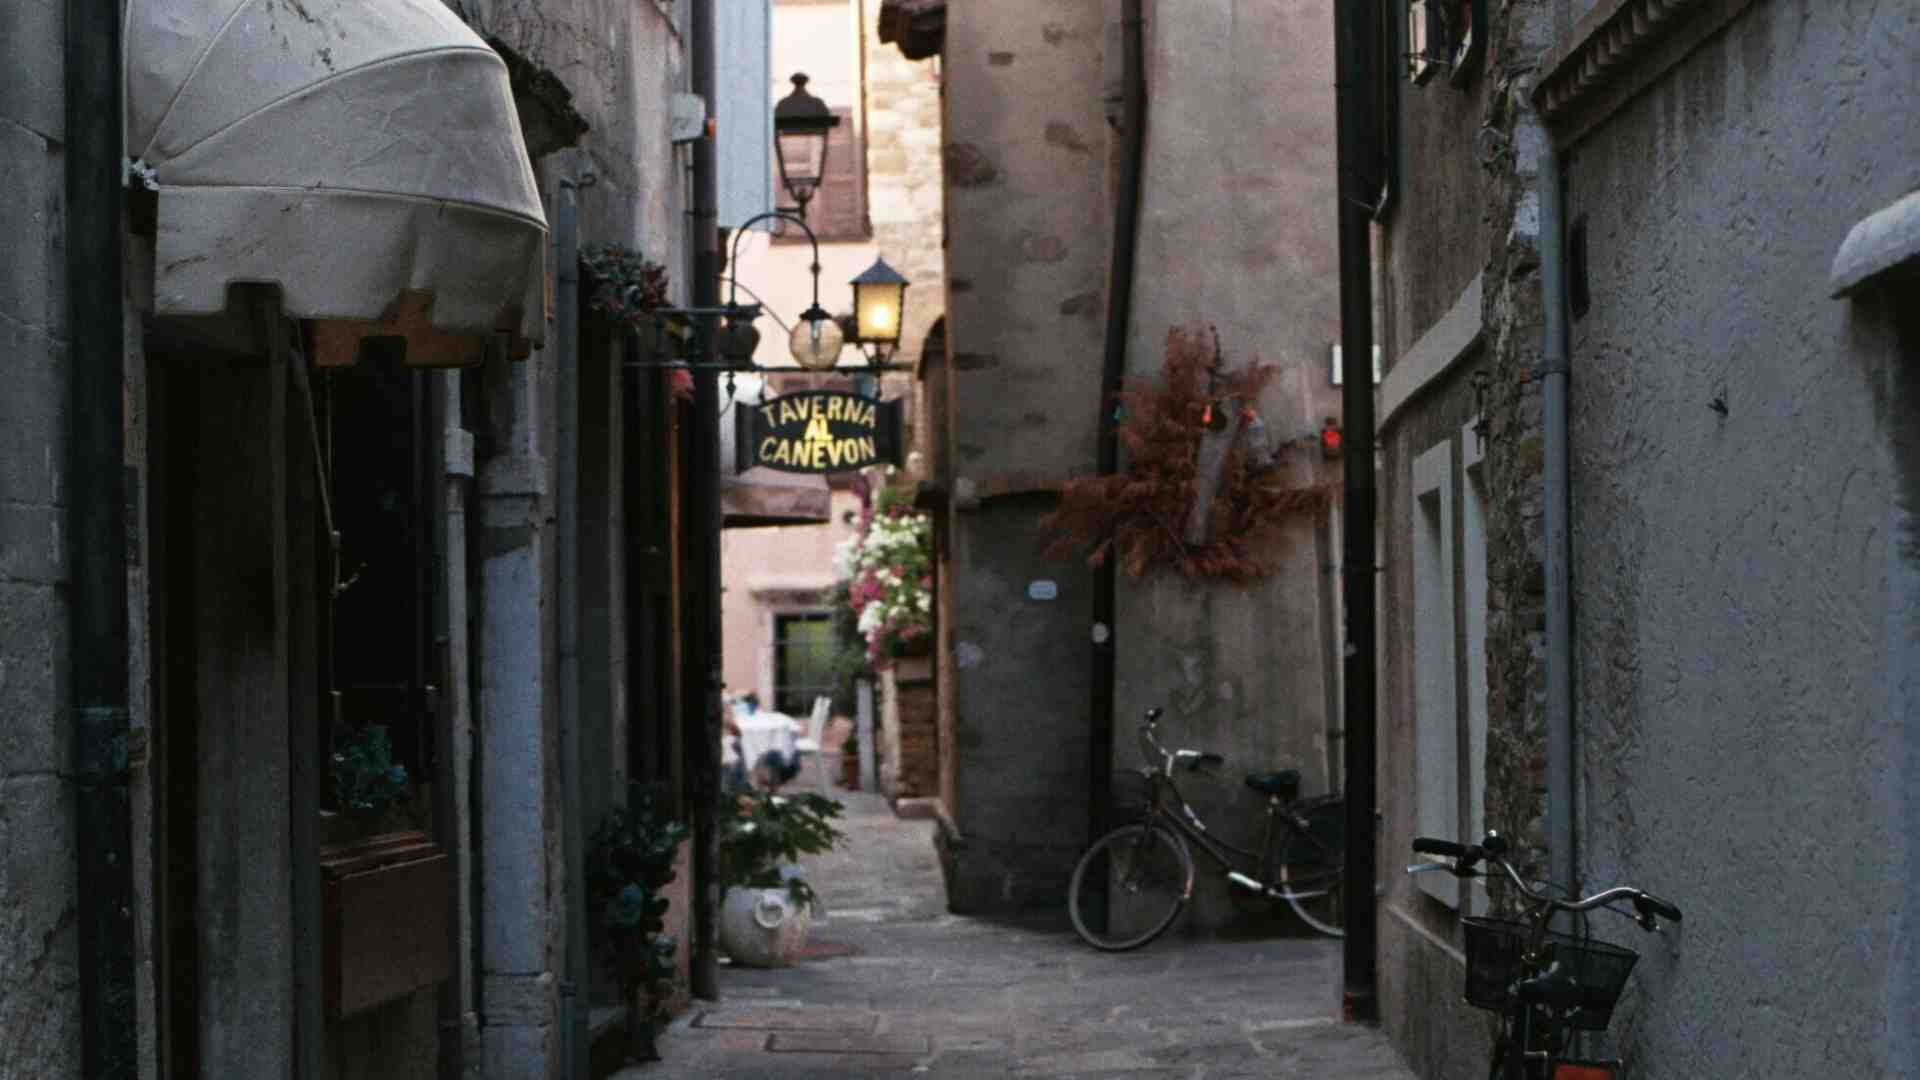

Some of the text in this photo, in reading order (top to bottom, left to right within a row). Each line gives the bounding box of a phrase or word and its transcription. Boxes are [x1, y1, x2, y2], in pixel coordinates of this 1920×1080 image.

[760, 396, 876, 428] TAVERNA
[804, 413, 834, 441] AL
[759, 436, 876, 468] CANEVON
